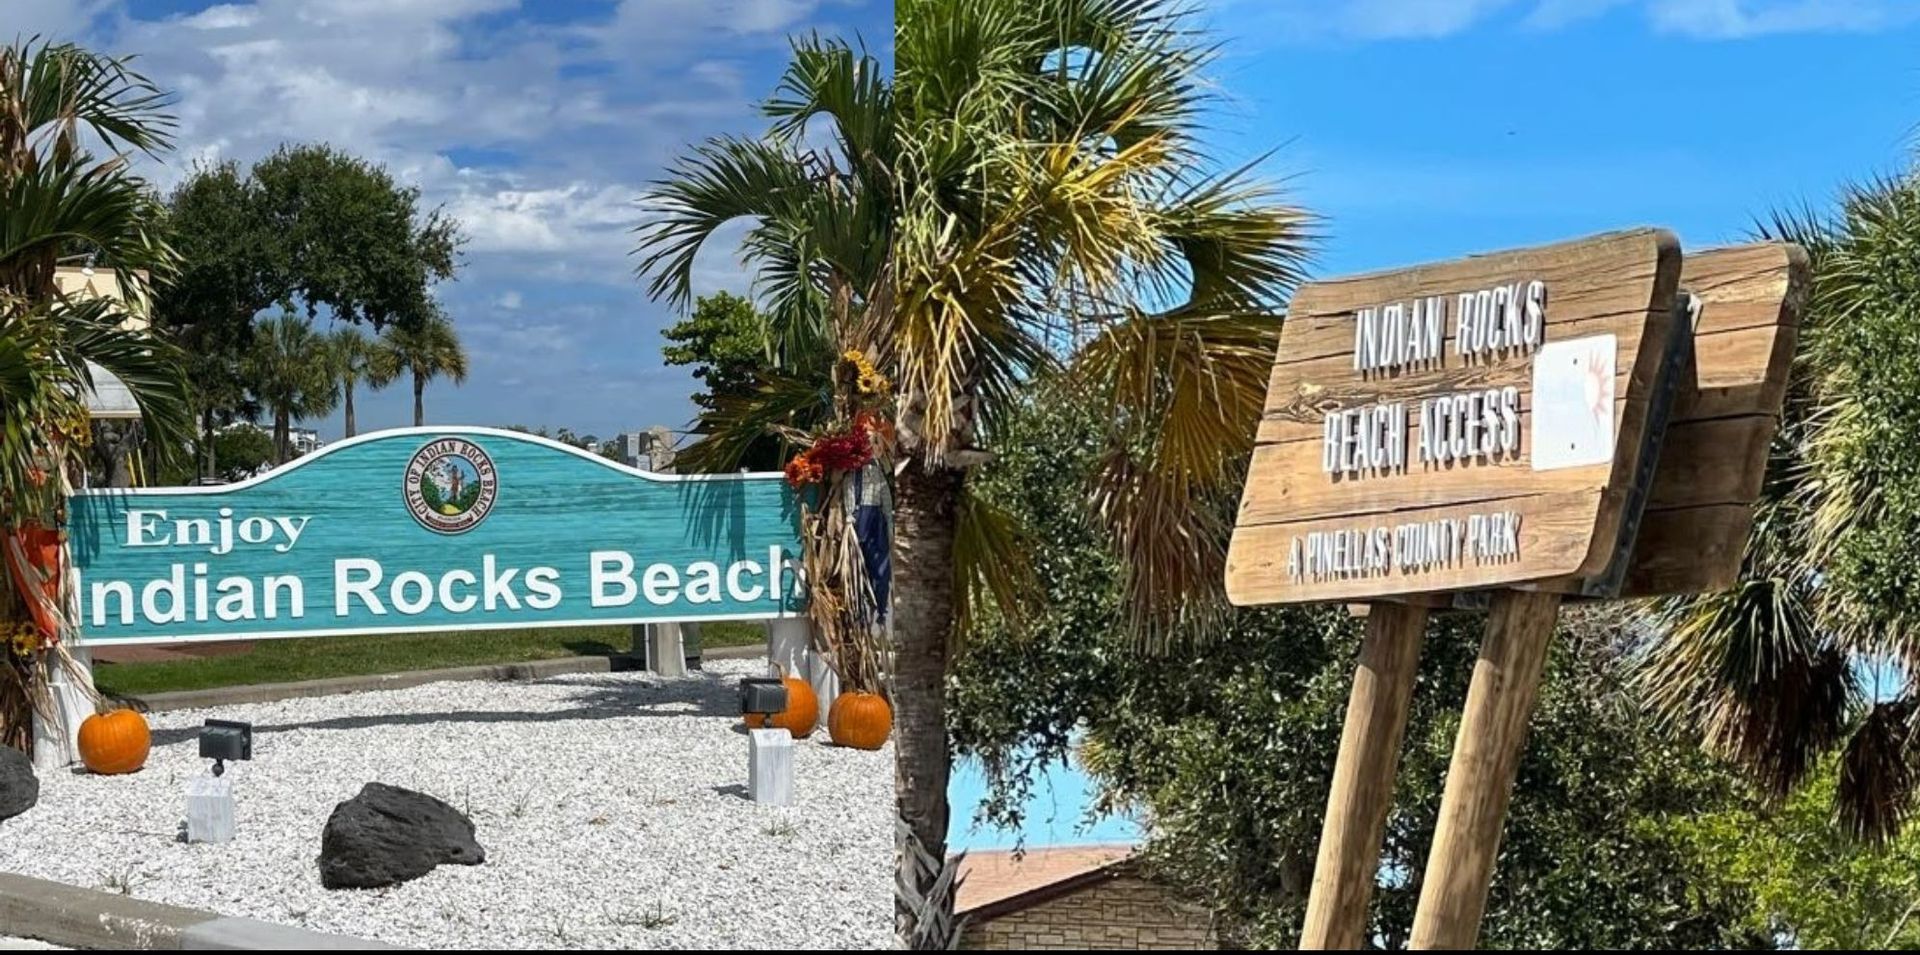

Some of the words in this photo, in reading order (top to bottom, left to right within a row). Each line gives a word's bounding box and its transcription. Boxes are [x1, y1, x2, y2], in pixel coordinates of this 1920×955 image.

[1353, 296, 1446, 371] INDIAN
[1455, 280, 1545, 356] ROCKS
[1323, 402, 1406, 473] BEACH
[1418, 386, 1519, 463] ACCESS
[416, 441, 456, 467] INDIAN
[460, 444, 491, 476] ROCKS
[408, 468, 421, 485] OF
[409, 489, 428, 516] CITY
[472, 480, 494, 517] BEACH
[120, 507, 312, 555] Enjoy
[1288, 535, 1302, 577] A
[1305, 526, 1390, 576] PINELLAS
[1393, 518, 1464, 567] COUNTY
[1467, 510, 1520, 559] PARK
[334, 553, 563, 617] Rocks
[590, 544, 808, 608] Beach
